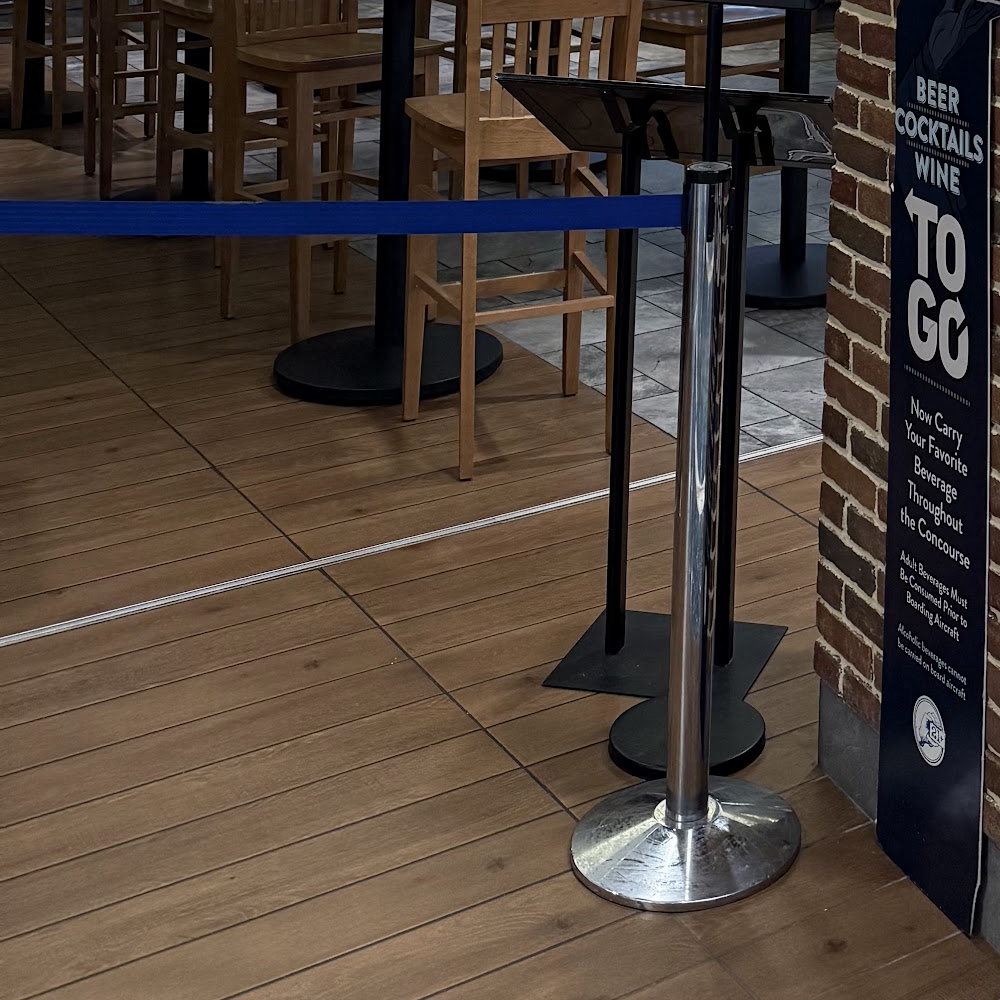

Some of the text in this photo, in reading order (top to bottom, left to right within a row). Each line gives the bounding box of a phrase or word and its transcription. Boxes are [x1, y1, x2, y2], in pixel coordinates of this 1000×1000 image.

[916, 75, 960, 116] BEER
[895, 107, 984, 164] COCKTAILS
[914, 151, 961, 196] WINE
[904, 187, 966, 293] TO
[907, 278, 969, 380] GO
[905, 419, 968, 477] Your Favorite
[910, 395, 963, 450] Now Carry
[907, 479, 963, 535] Throughout
[914, 455, 958, 504] Beverage
[900, 506, 971, 569] the Concourse
[900, 550, 968, 609] Adult Beverages Must
[900, 567, 968, 628] Be Consumed Prior to
[906, 590, 960, 642] Boarding Aircraft
[897, 623, 966, 685] Alcoholic beverages cannot
[897, 636, 966, 701] be carried on board aircraft
